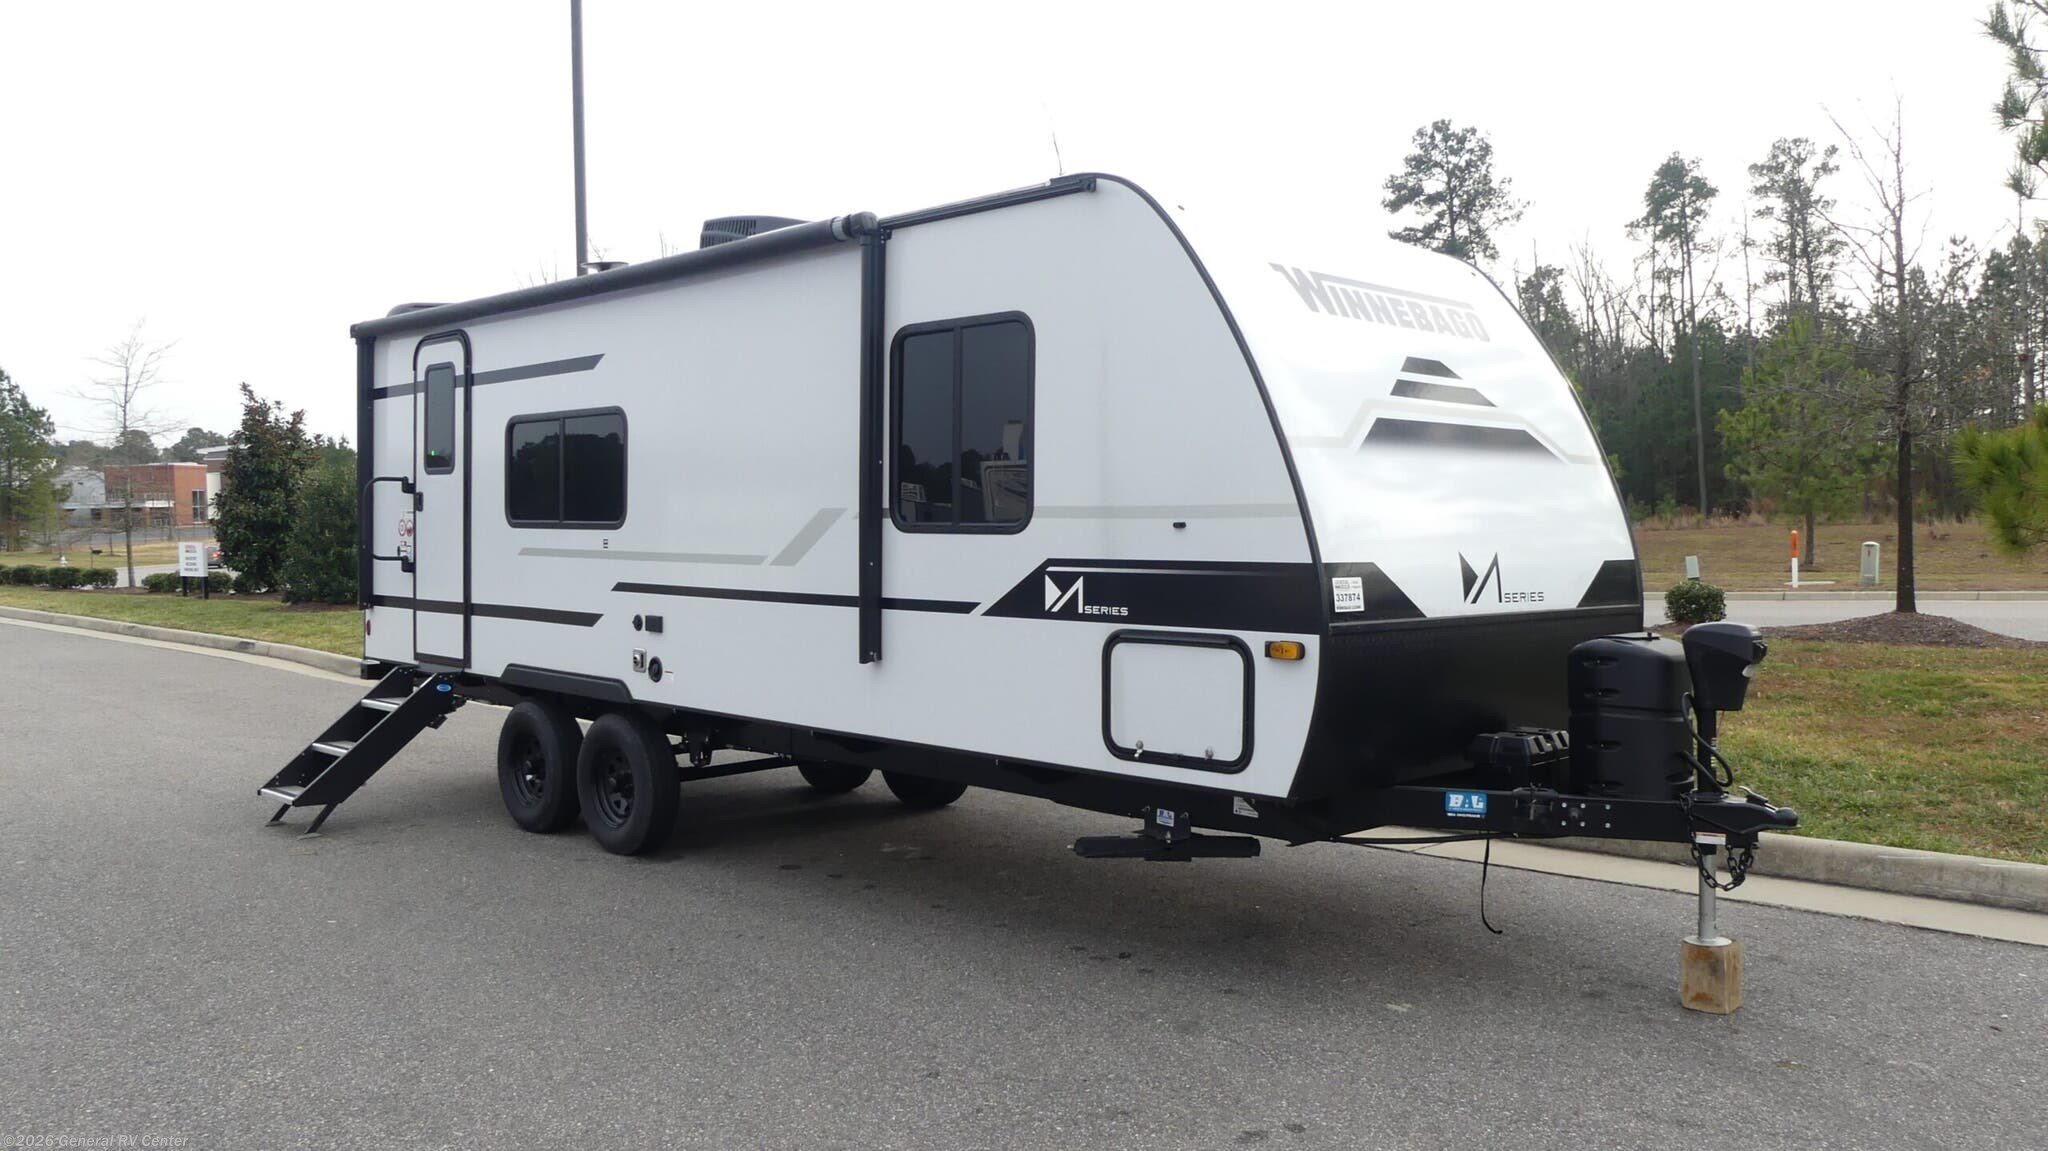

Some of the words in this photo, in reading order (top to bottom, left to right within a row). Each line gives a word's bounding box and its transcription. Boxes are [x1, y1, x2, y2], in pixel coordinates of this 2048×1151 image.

[1268, 262, 1491, 343] WINNEBAGO
[1336, 592, 1361, 602] 337874
[1504, 591, 1544, 603] SERIES
[1084, 605, 1129, 616] SERIES
